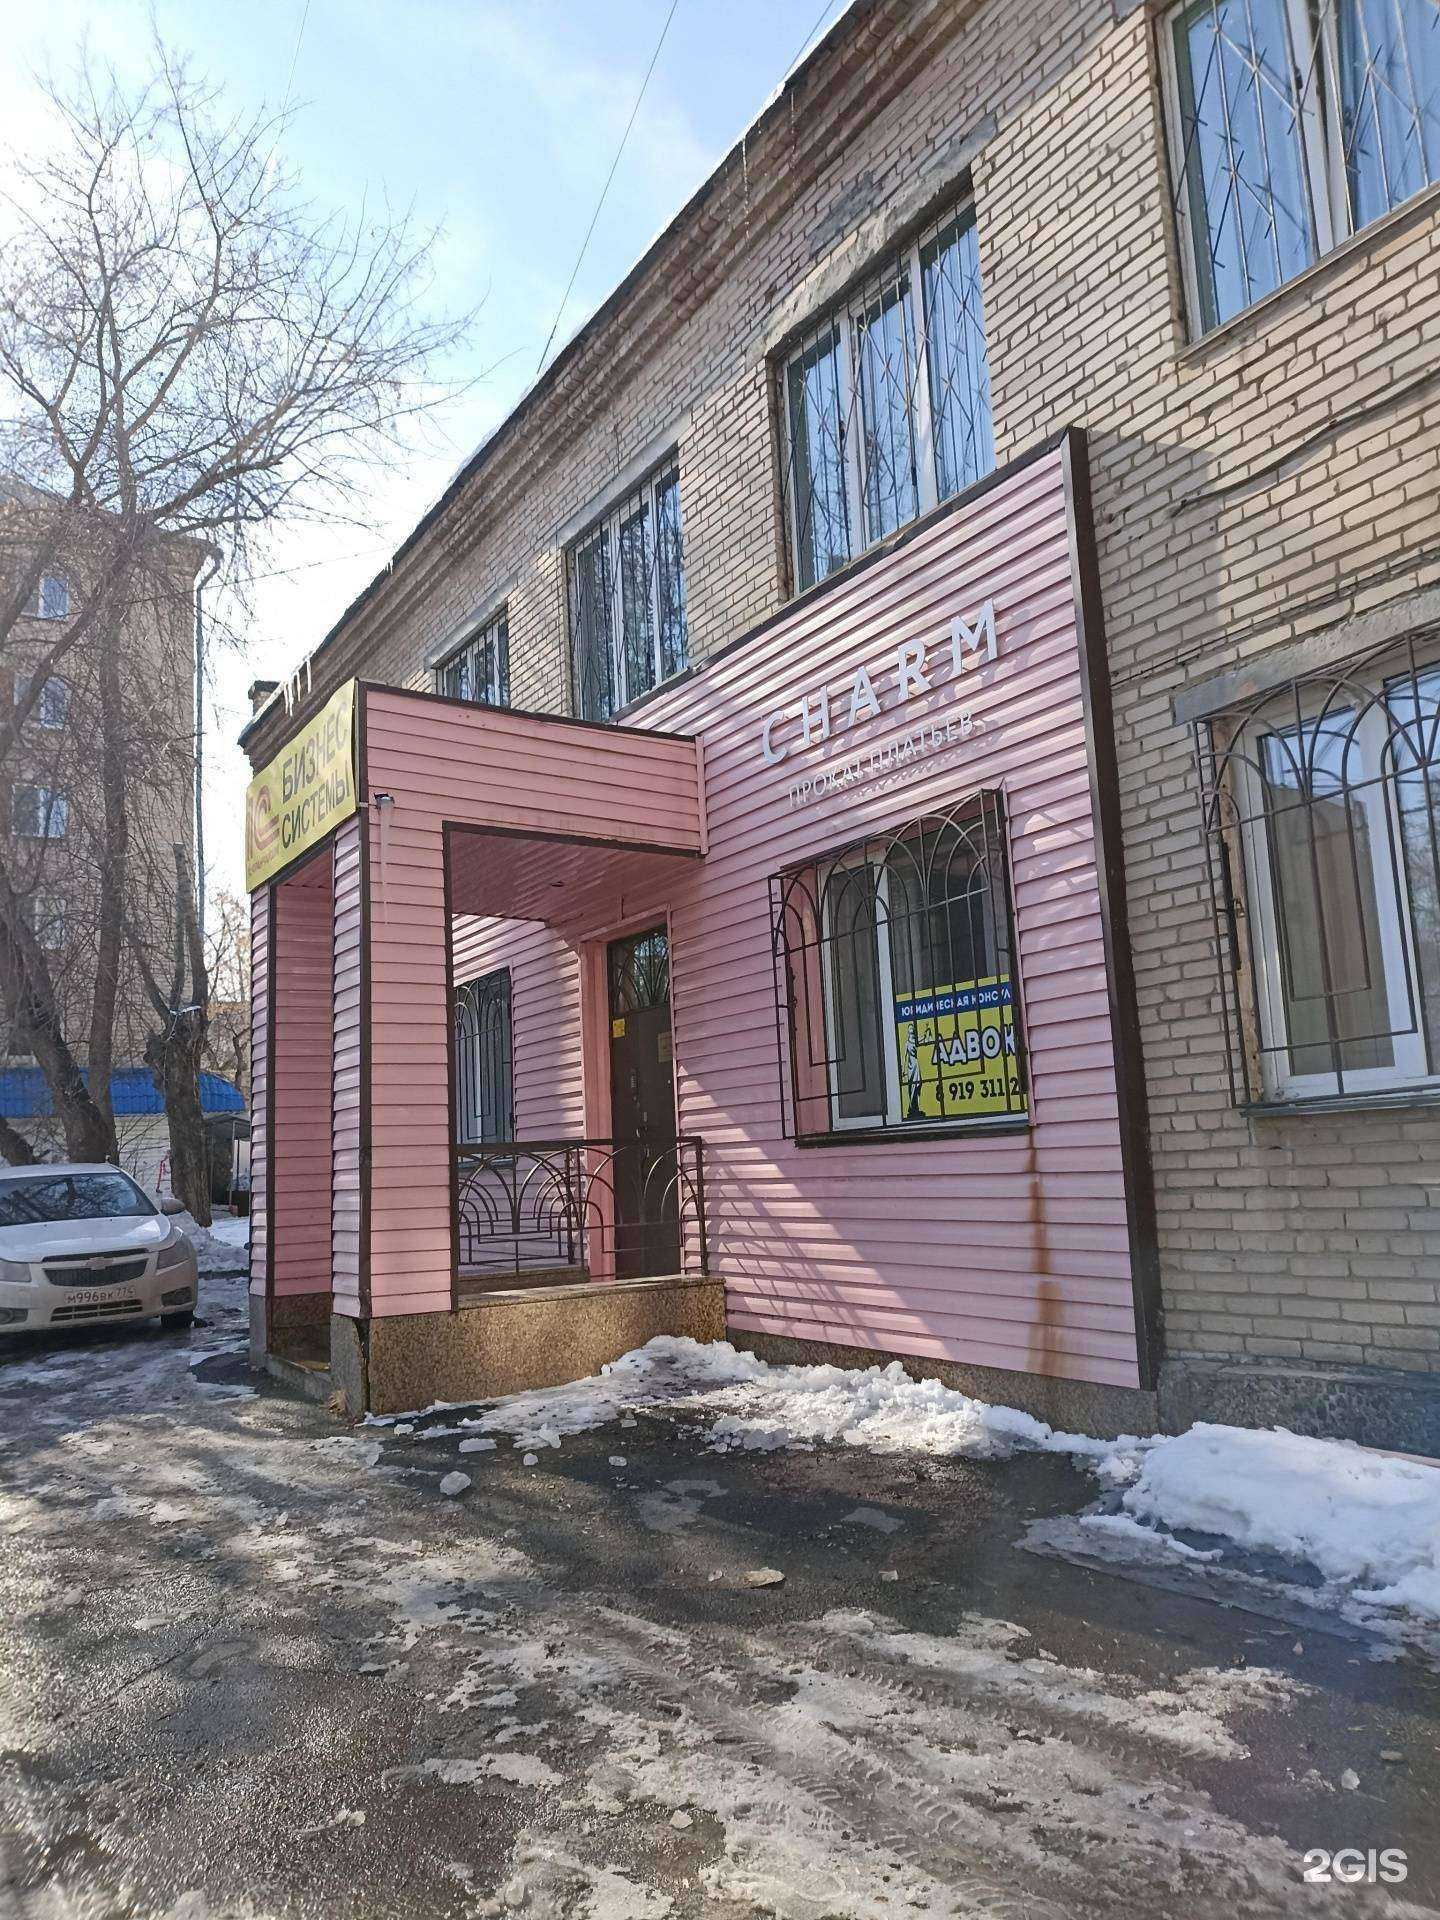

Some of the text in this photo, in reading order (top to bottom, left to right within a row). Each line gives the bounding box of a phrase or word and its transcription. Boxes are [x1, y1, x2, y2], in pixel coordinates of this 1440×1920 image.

[762, 598, 999, 765] CHARM
[282, 701, 349, 804] БИЗНЕС
[869, 711, 974, 772] ПЛАТЬЕВ
[281, 760, 351, 850] СИСТЕМЫ
[949, 1081, 975, 1101] 919
[980, 1078, 1005, 1098] 311
